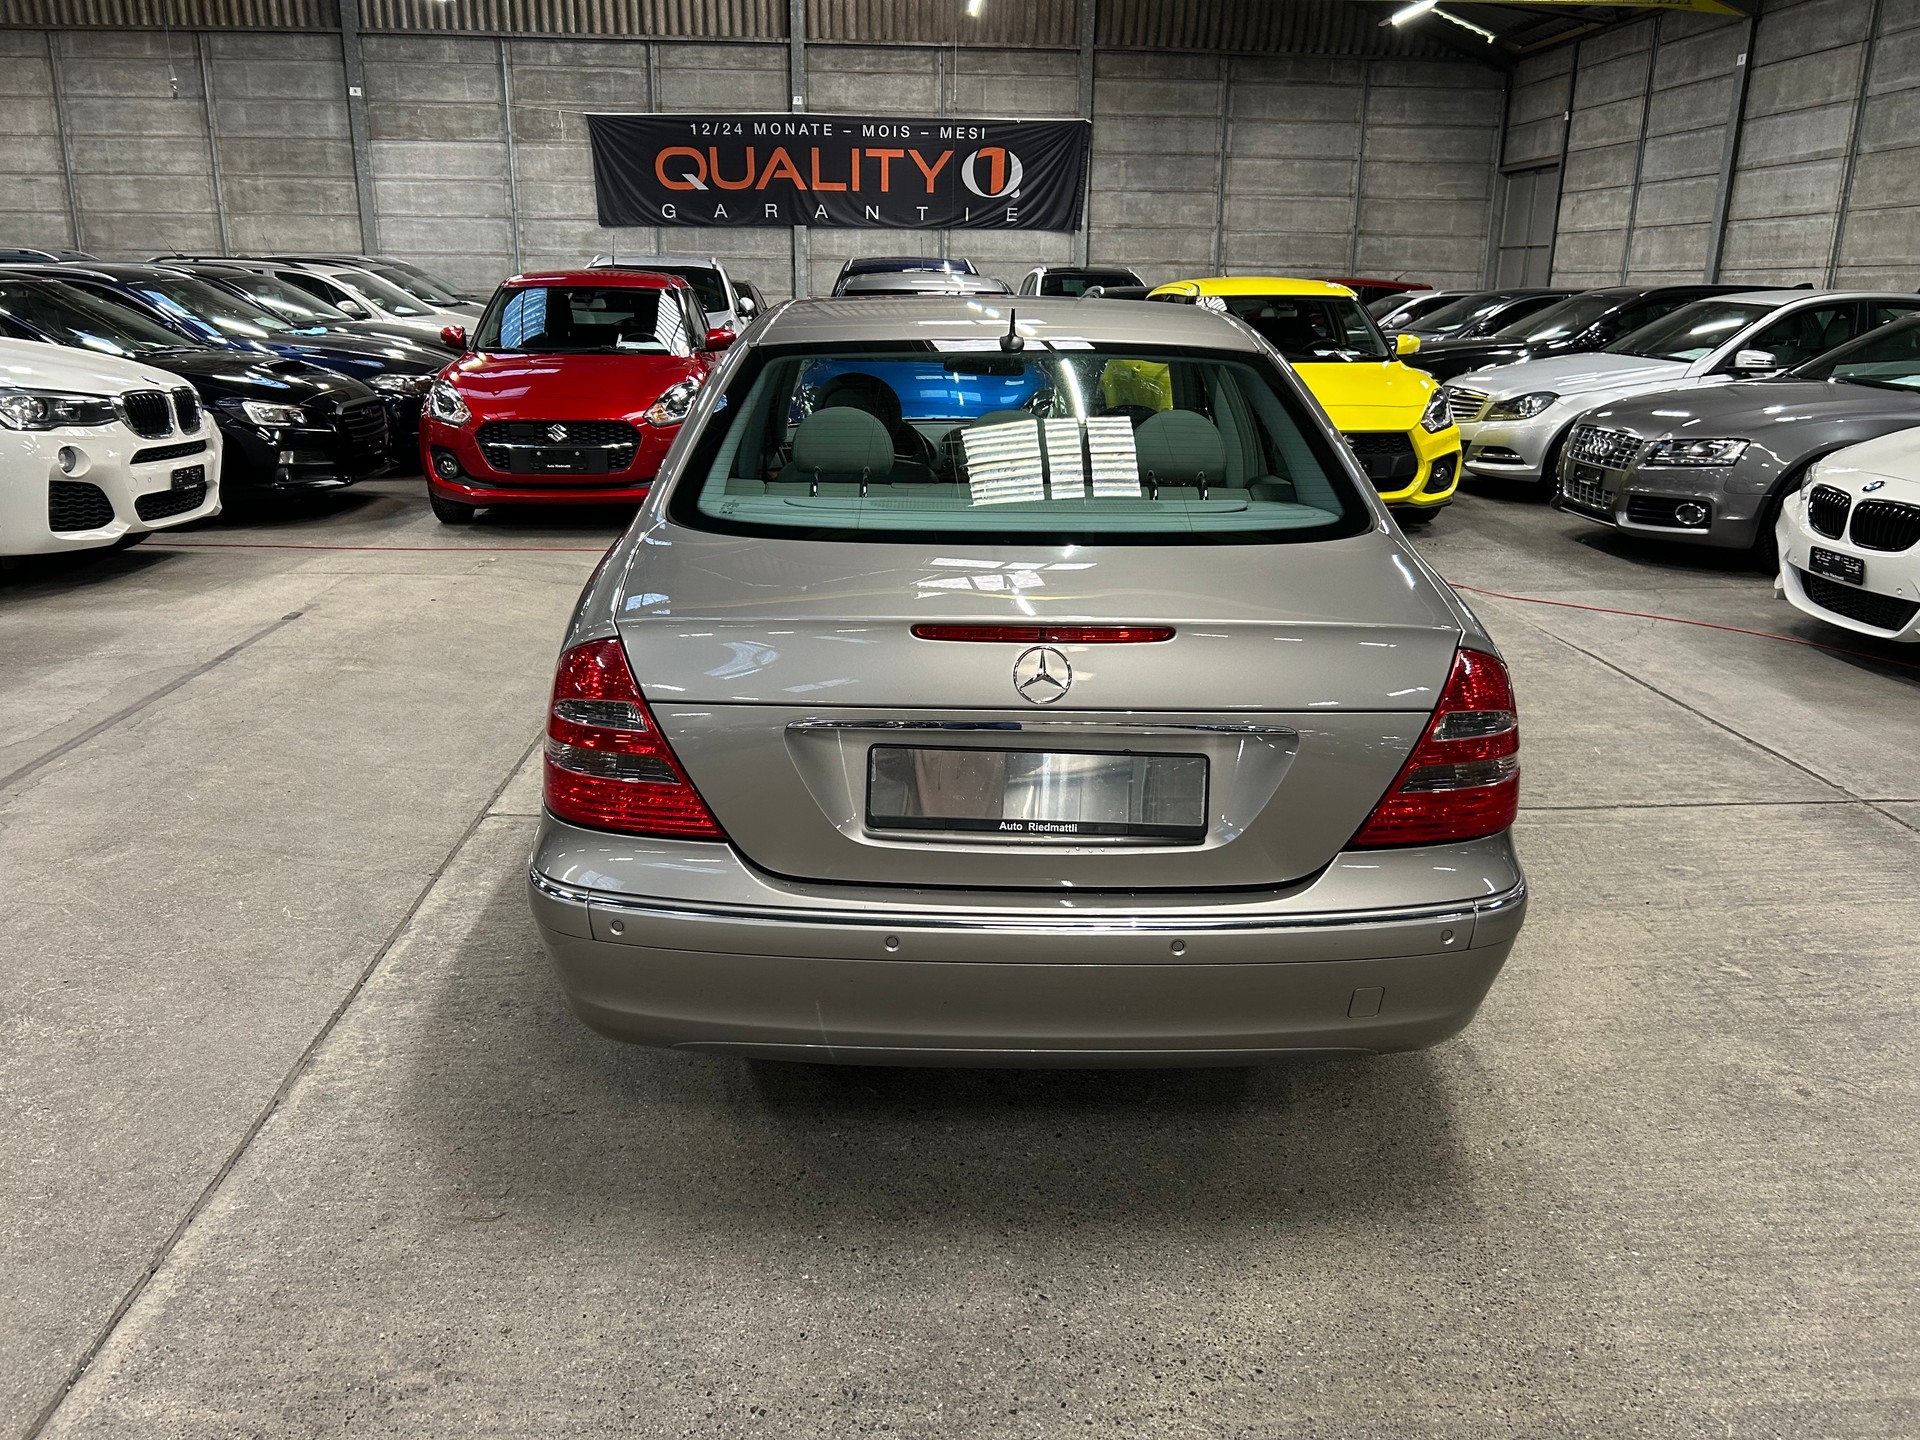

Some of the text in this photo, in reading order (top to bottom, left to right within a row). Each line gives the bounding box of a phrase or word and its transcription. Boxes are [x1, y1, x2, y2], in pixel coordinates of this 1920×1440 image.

[689, 122, 743, 136] 12/24
[753, 122, 834, 137] MONATE
[862, 124, 911, 139] MOIS
[939, 126, 986, 140] MESI
[655, 146, 954, 194] QUALITY
[661, 203, 1019, 222] GARANTIE
[999, 821, 1078, 833] Auto Riedmattli
